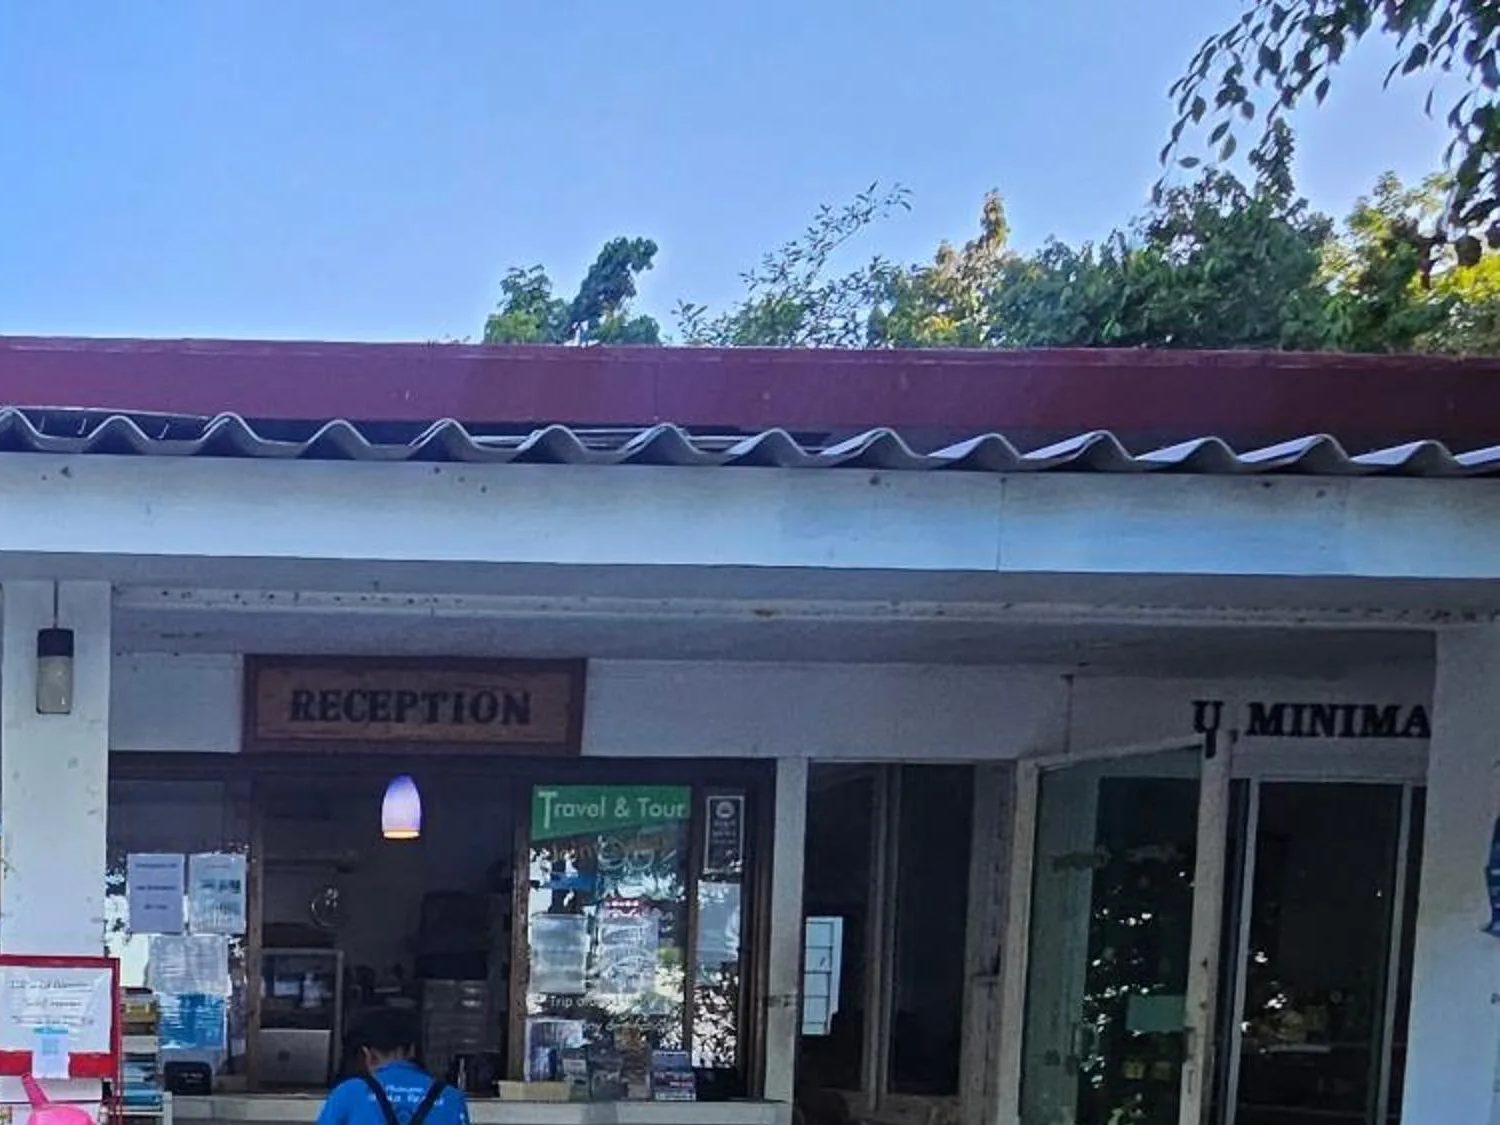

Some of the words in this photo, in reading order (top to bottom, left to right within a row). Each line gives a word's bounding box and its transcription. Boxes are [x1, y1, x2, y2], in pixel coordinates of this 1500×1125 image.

[290, 688, 532, 725] RECEPTION
[537, 791, 606, 830] Travel
[614, 798, 631, 818] &
[637, 797, 687, 818] Tour
